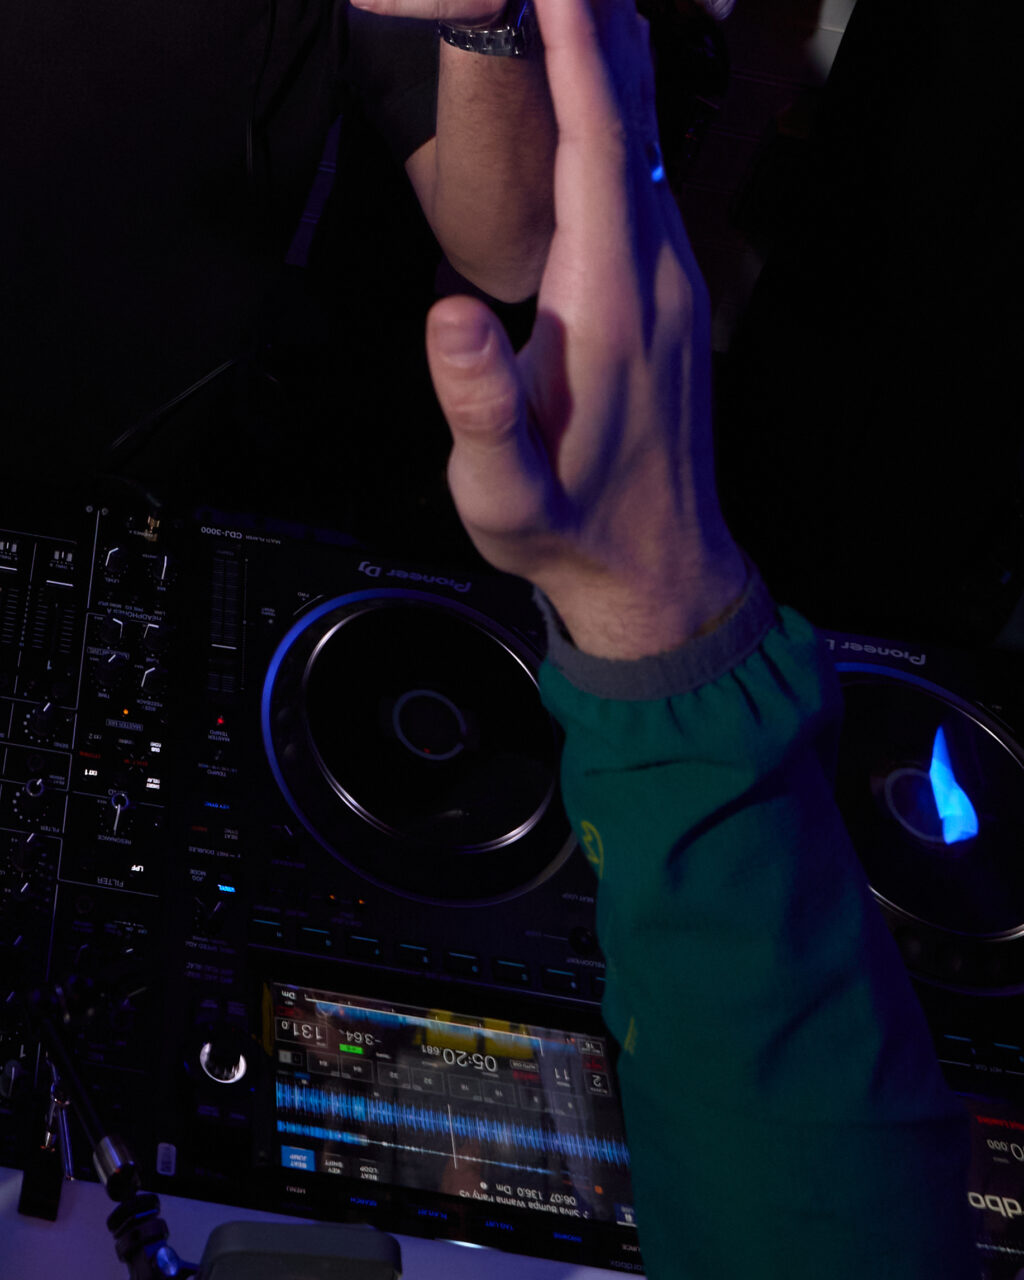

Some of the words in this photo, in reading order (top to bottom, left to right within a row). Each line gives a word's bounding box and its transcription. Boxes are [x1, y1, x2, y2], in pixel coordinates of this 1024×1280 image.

[200, 526, 243, 540] CDJ-3000
[386, 568, 472, 593] Pioneer
[114, 608, 162, 621] HEADPHONES
[840, 641, 926, 666] Pioneer
[45, 659, 52, 671] 1
[136, 699, 163, 708] FEEDBACK
[97, 834, 132, 846] RESONANCE
[129, 864, 144, 873] LPF
[96, 876, 124, 888] FILTER
[281, 989, 297, 1001] Dm
[19, 1044, 26, 1058] 1
[553, 1067, 571, 1081] 11
[591, 1074, 603, 1087] 2
[285, 1185, 306, 1195] MENU
[495, 1182, 512, 1195] Dm
[516, 1186, 544, 1201] 136.0
[349, 1196, 377, 1208] SEARCH
[495, 1193, 527, 1208] Wanna
[549, 1191, 577, 1206] 06:07
